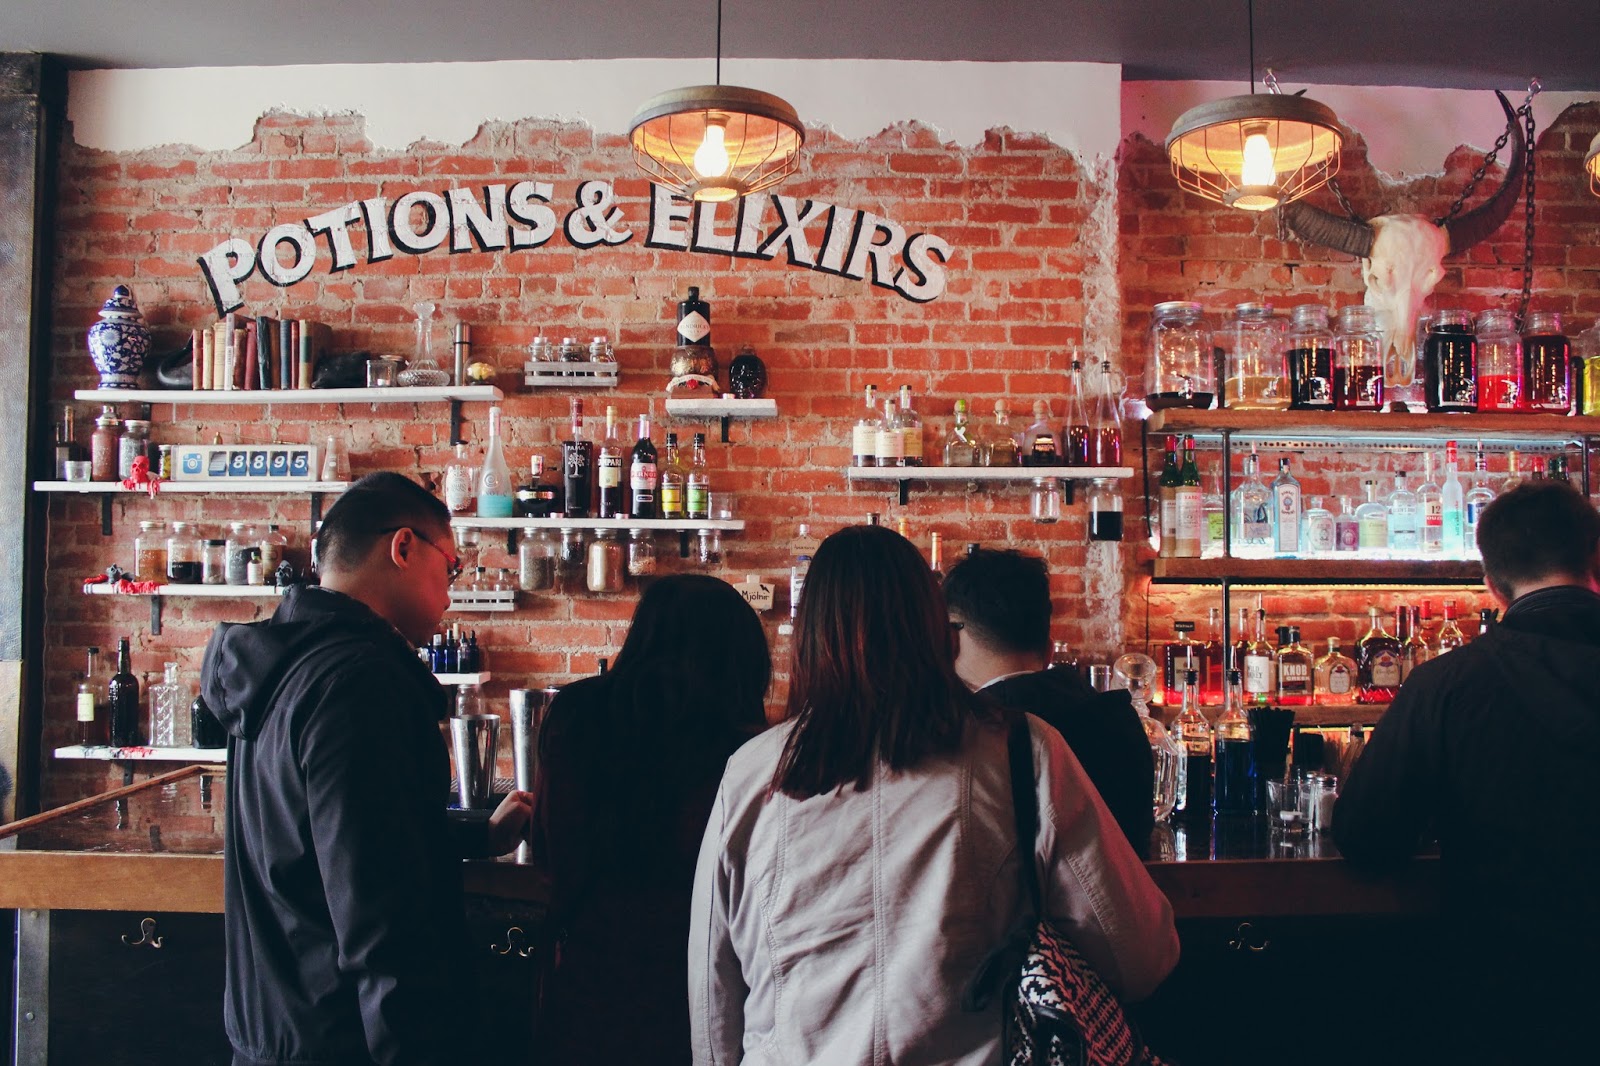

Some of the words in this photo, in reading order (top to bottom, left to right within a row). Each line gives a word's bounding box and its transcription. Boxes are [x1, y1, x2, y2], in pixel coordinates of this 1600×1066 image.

[198, 181, 555, 317] POTIONS
[563, 180, 634, 249] &
[645, 183, 953, 302] ELIXIRS
[598, 458, 622, 467] CMPARI
[1431, 505, 1441, 514] 12
[1283, 664, 1307, 676] KNOB
